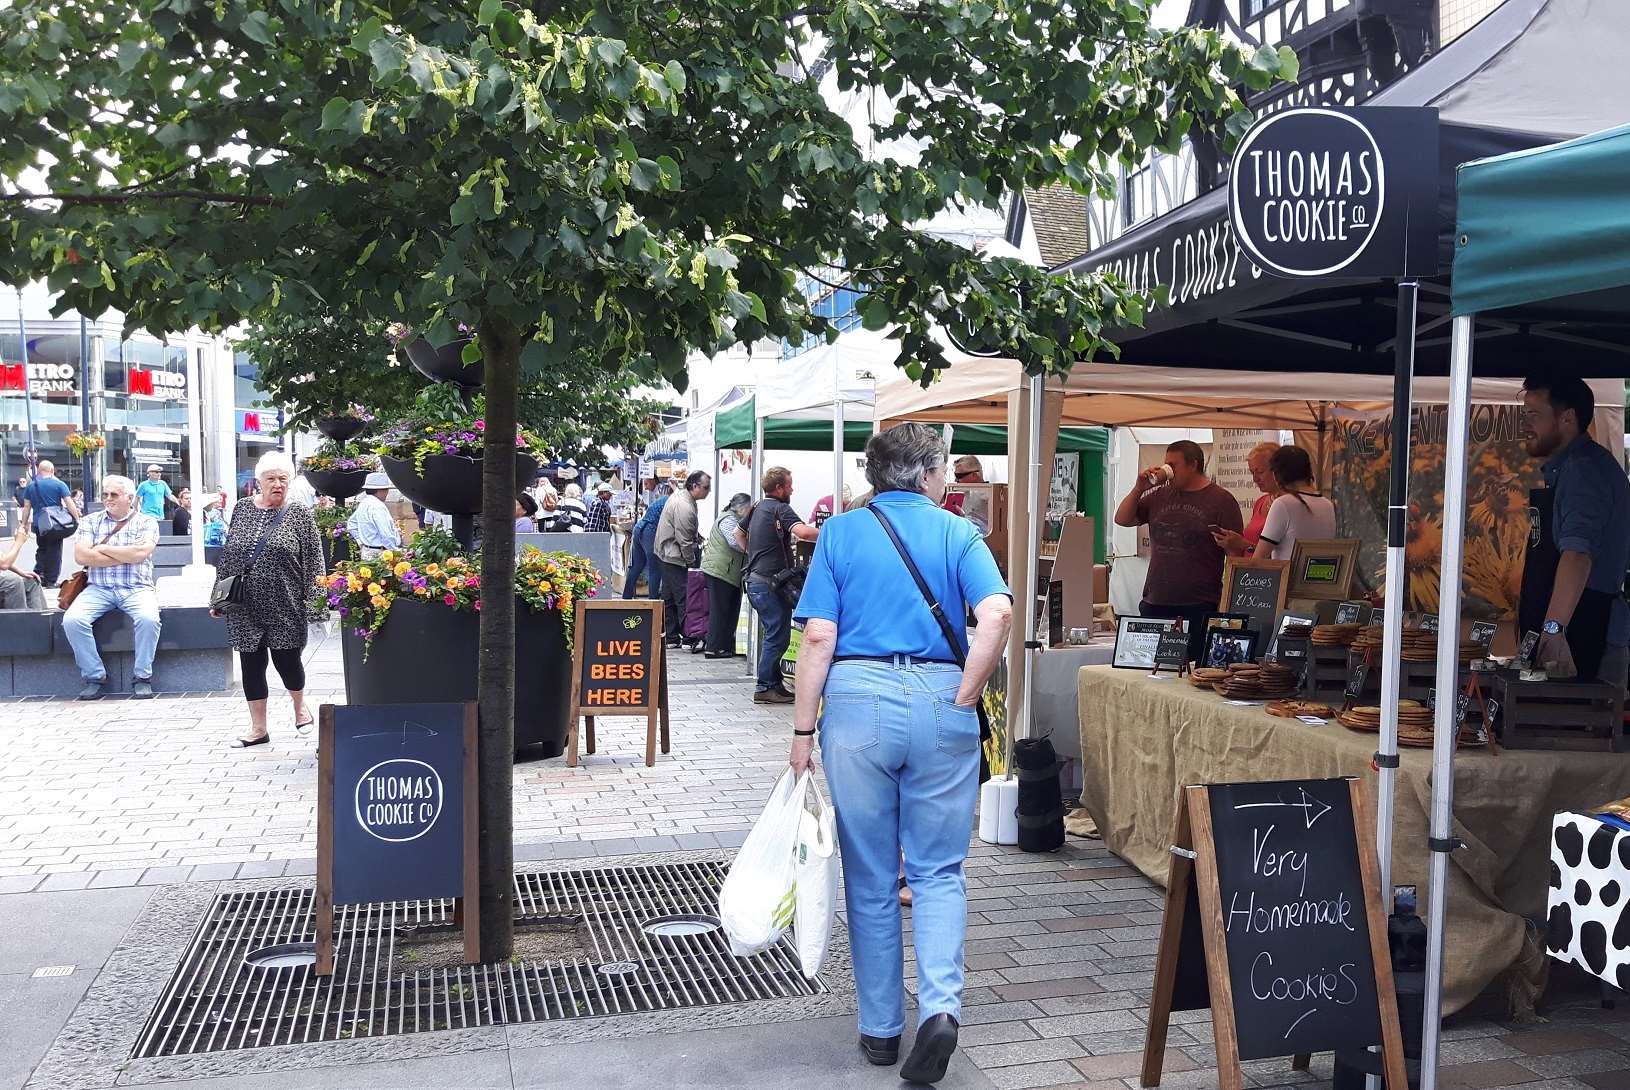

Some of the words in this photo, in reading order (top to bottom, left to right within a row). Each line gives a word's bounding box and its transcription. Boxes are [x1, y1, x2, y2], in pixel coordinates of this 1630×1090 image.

[1250, 150, 1372, 198] THOMAS
[1263, 199, 1348, 242] COOKIE
[29, 380, 75, 391] BANK
[1239, 572, 1272, 588] Cookies
[596, 640, 642, 656] LIVE
[591, 663, 645, 680] BEES
[586, 688, 643, 705] HERE
[367, 776, 433, 801] THOMAS
[367, 803, 415, 825] COOKIE
[1253, 824, 1308, 897] Very
[1226, 891, 1355, 933] Homemade
